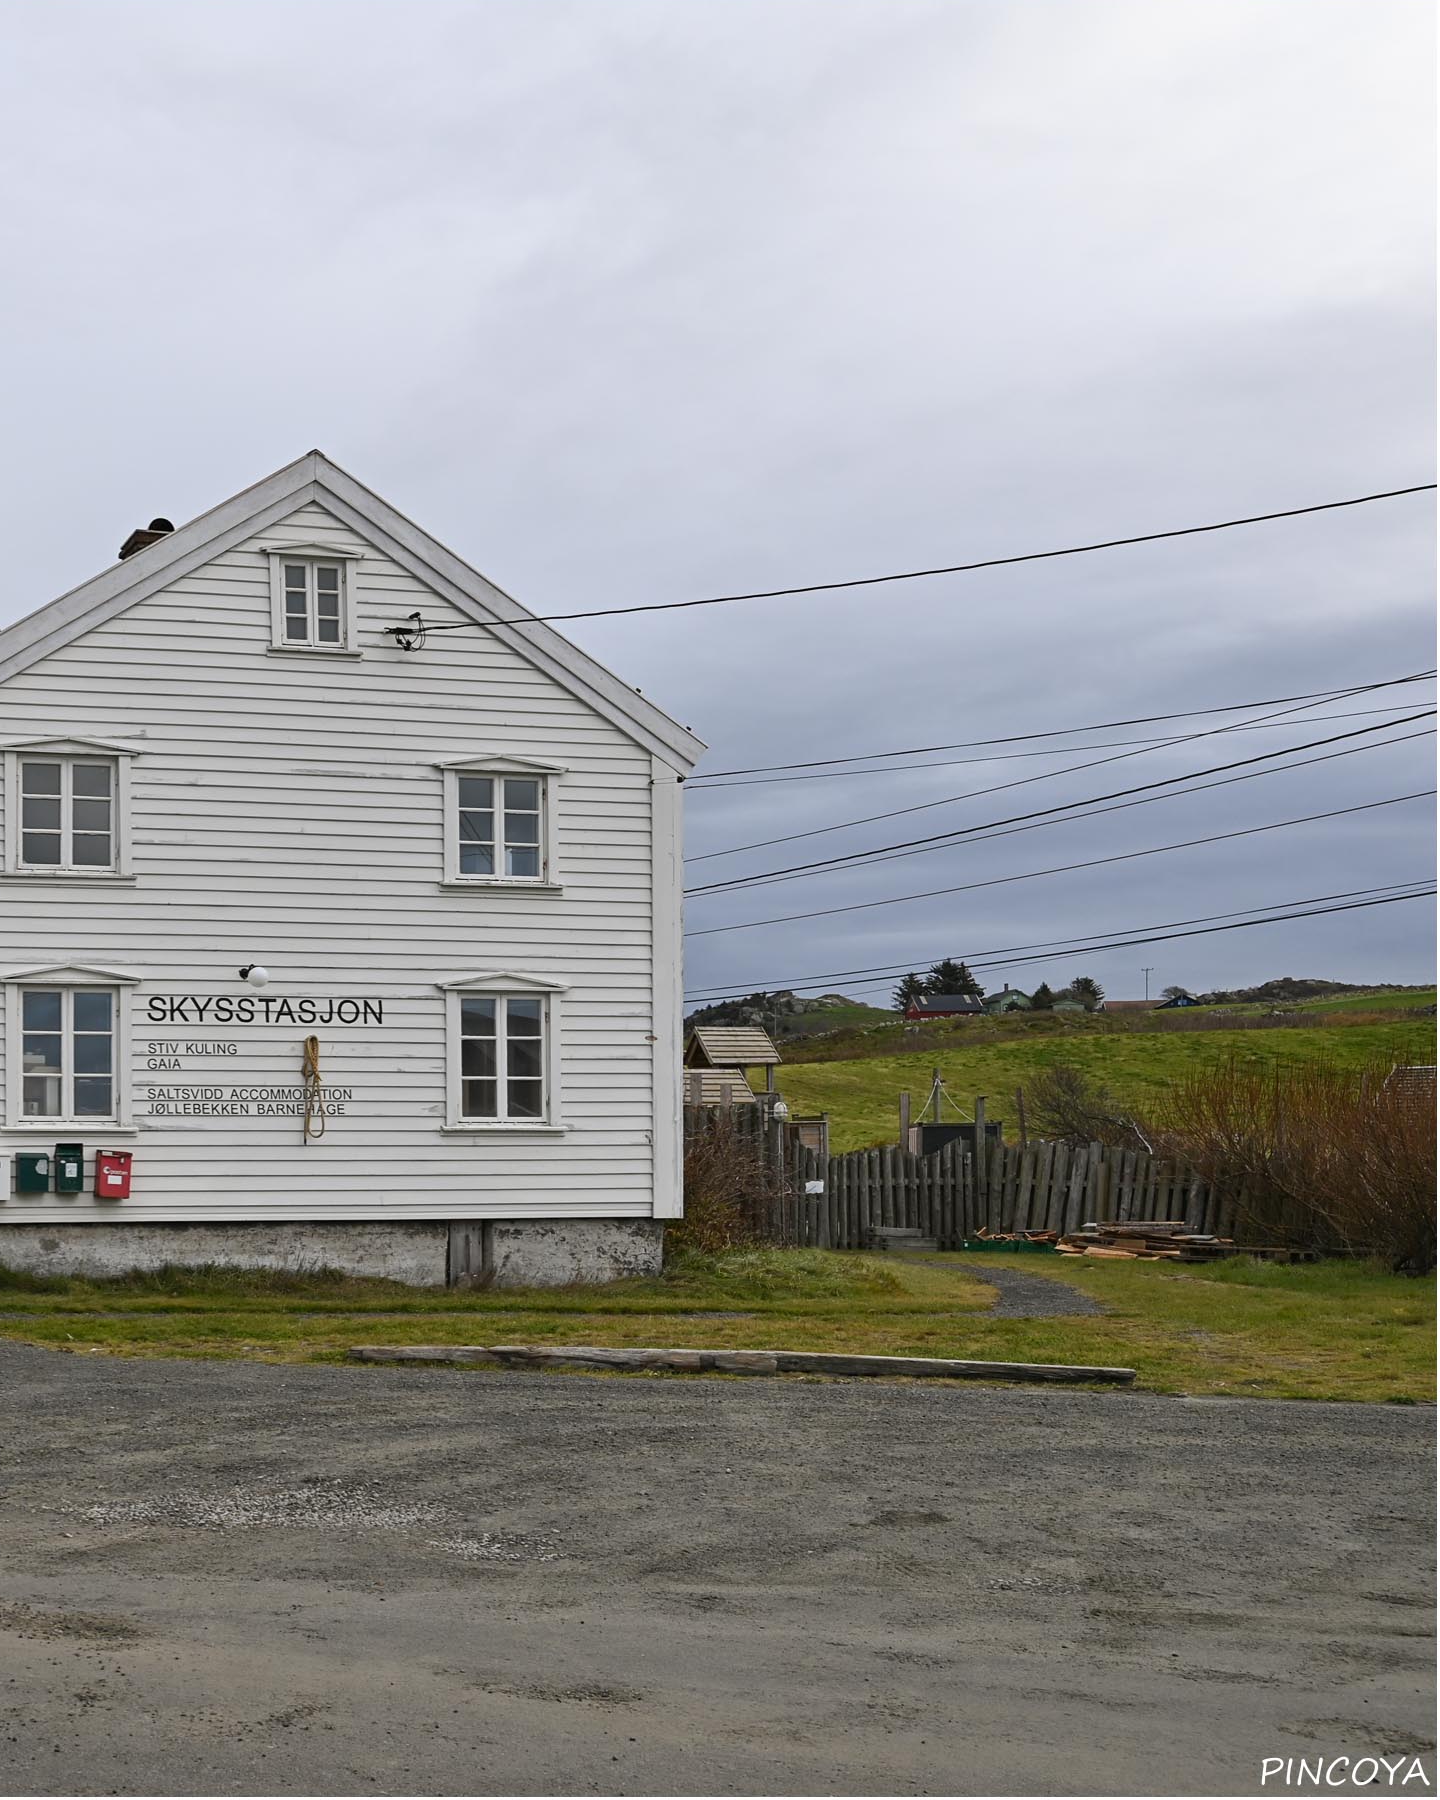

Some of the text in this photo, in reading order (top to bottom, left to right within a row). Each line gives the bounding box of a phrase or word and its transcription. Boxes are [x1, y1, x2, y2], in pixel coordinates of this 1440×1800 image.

[147, 996, 384, 1025] SKYSSTASJON
[147, 1042, 238, 1055] STIV KULING
[147, 1058, 182, 1070] GAIA
[147, 1088, 353, 1100] SALTSVIDD ACCOMMODATION
[147, 1102, 250, 1115] JØLLEBEKKEN
